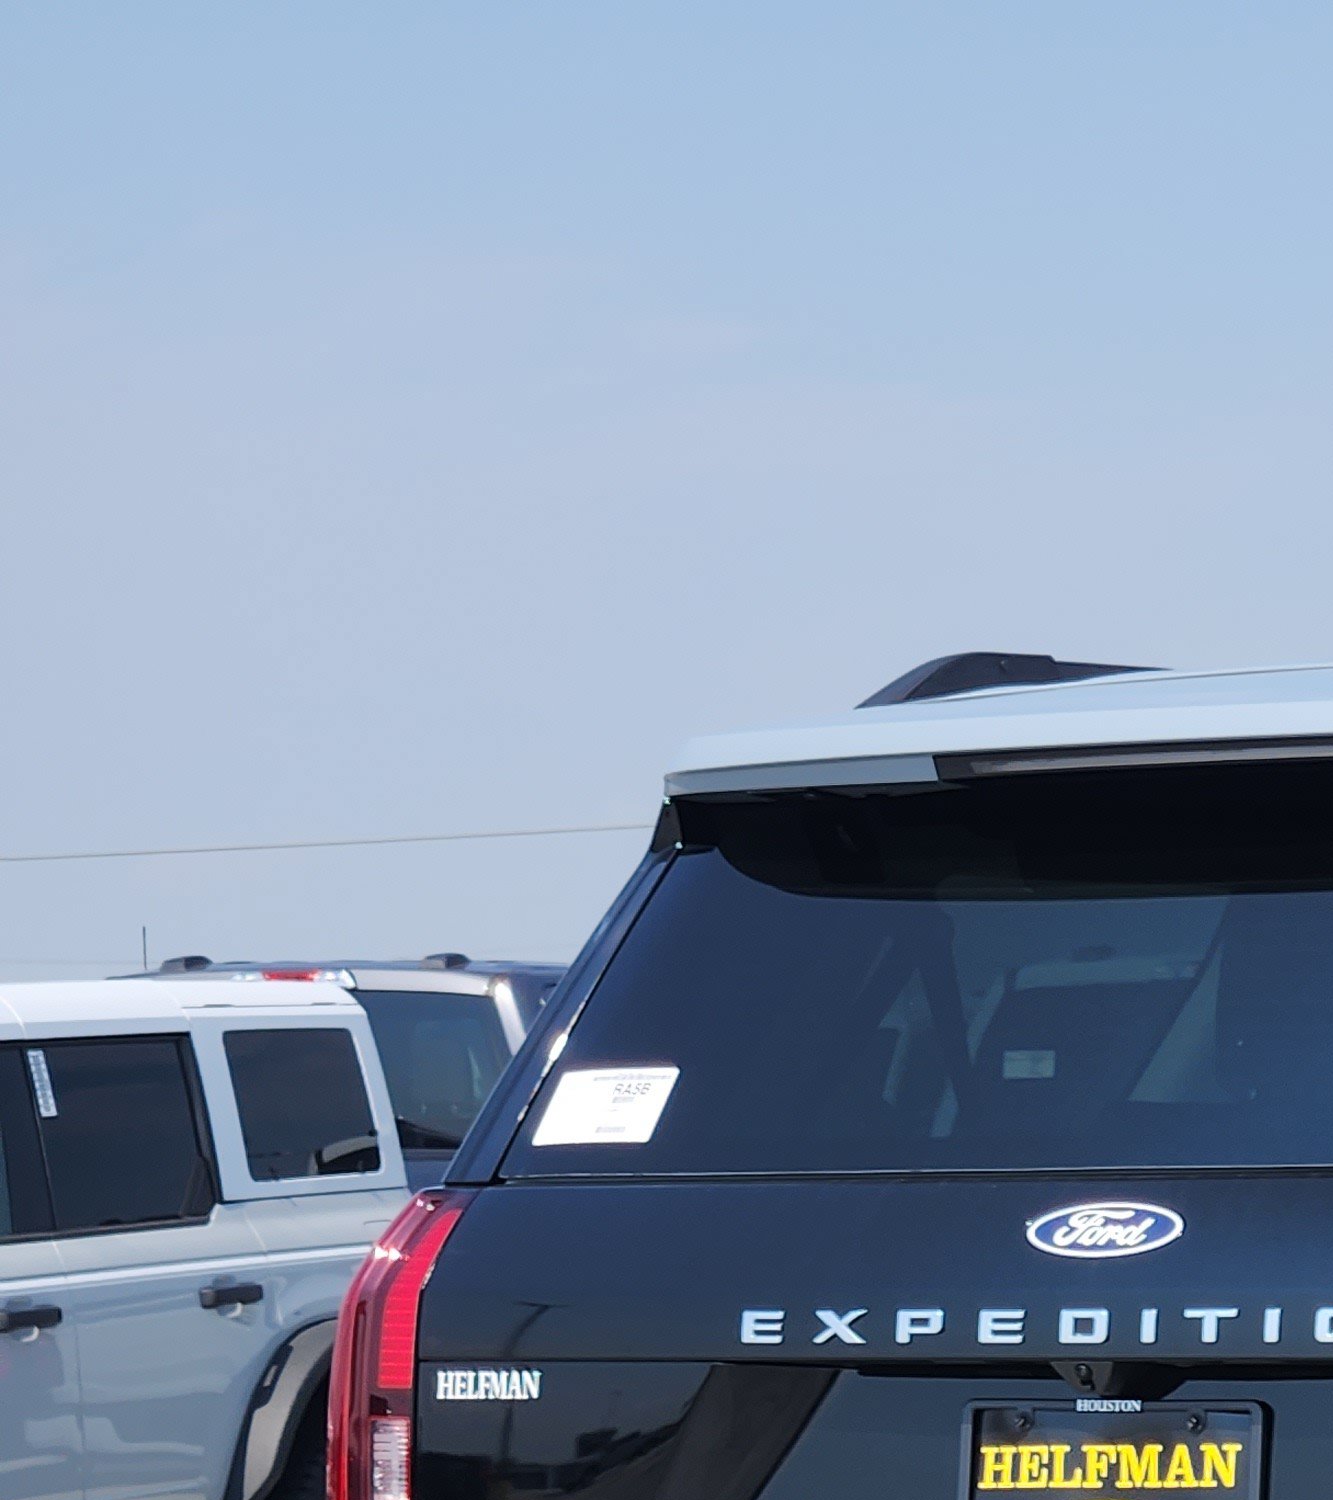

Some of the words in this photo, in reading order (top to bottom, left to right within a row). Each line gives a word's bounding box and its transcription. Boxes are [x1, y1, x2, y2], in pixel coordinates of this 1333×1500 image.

[1052, 1209, 1156, 1248] Ford
[436, 1369, 542, 1400] HELFMAN
[1076, 1399, 1142, 1413] HOUSTON
[976, 1443, 1243, 1490] HELFMAN
